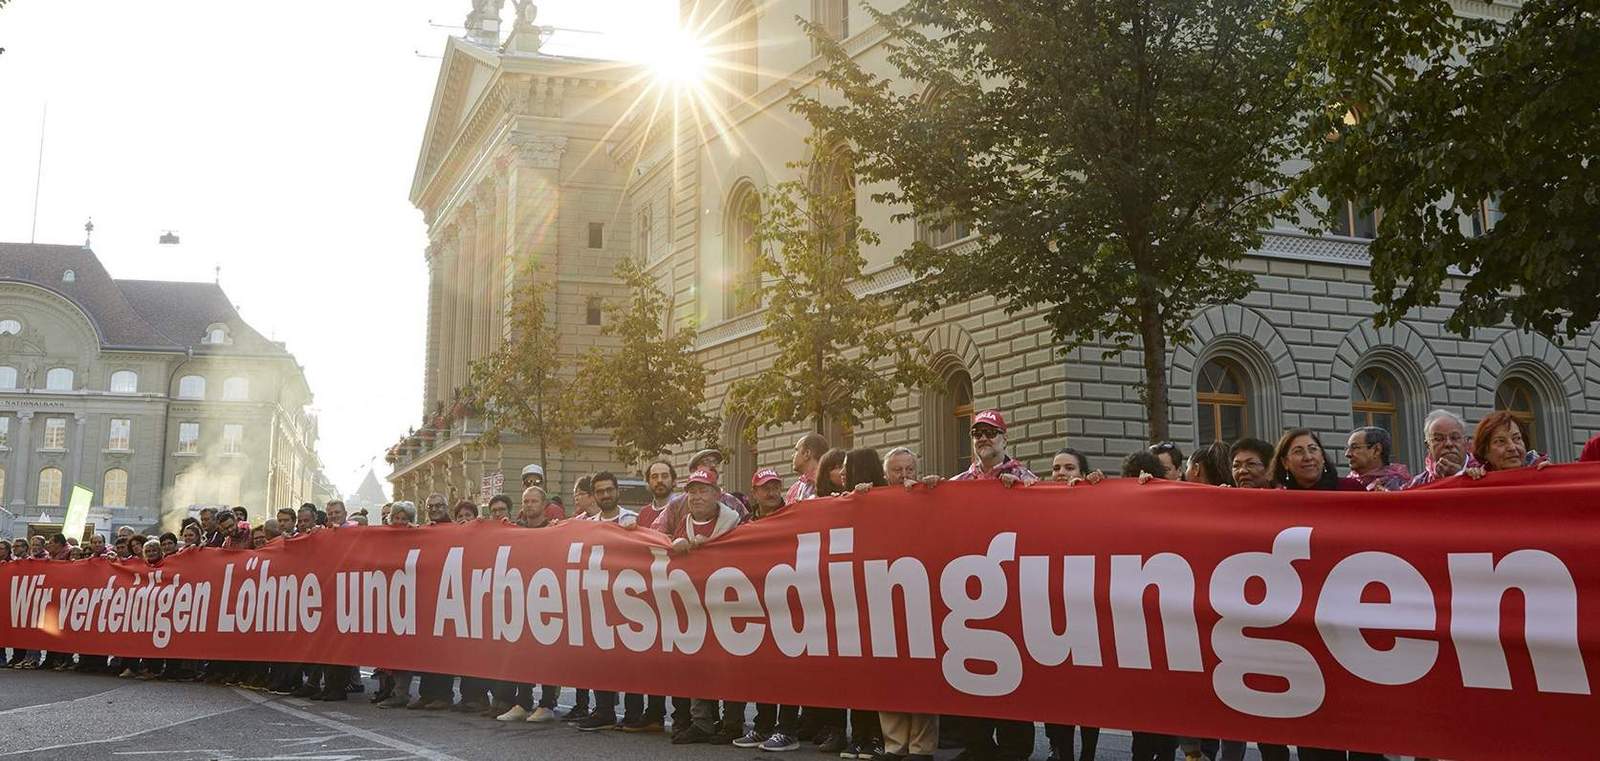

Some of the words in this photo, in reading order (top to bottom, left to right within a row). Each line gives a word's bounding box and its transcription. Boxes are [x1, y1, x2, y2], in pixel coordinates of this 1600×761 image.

[10, 574, 54, 628] Wir
[58, 569, 212, 649] verteidigen
[217, 556, 322, 634] Löhne
[336, 548, 421, 636] und
[432, 526, 1591, 718] Arbeitsbedingungen
